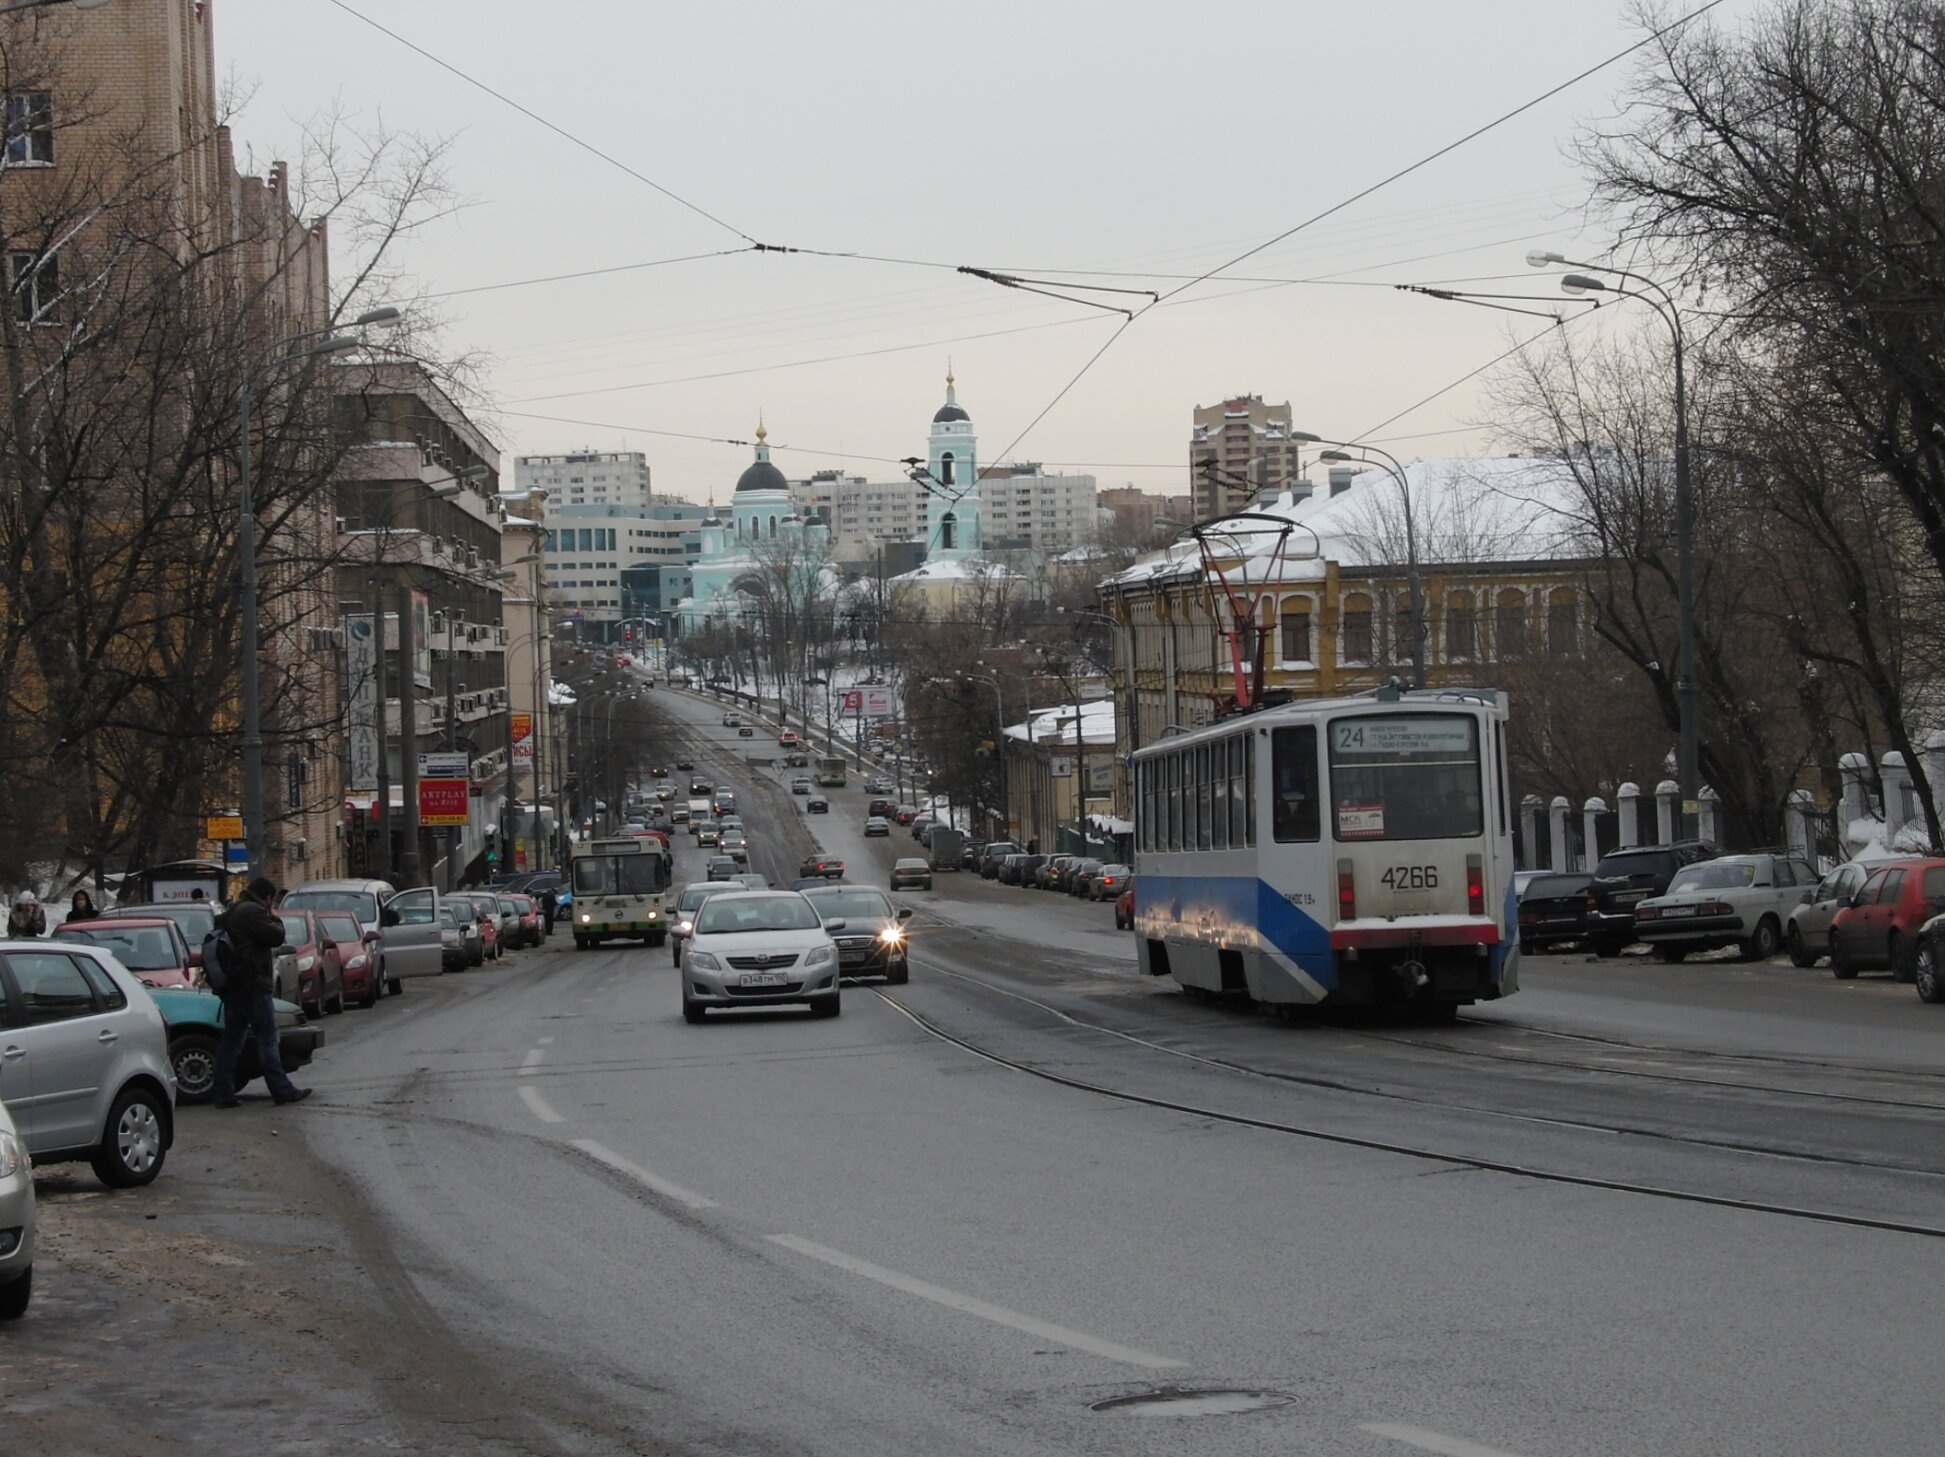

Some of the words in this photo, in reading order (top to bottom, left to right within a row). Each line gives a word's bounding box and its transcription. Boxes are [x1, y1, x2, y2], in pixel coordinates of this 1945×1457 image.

[1340, 727, 1364, 748] 24
[421, 790, 466, 799] ARTPLAY
[1381, 865, 1438, 889] 4266
